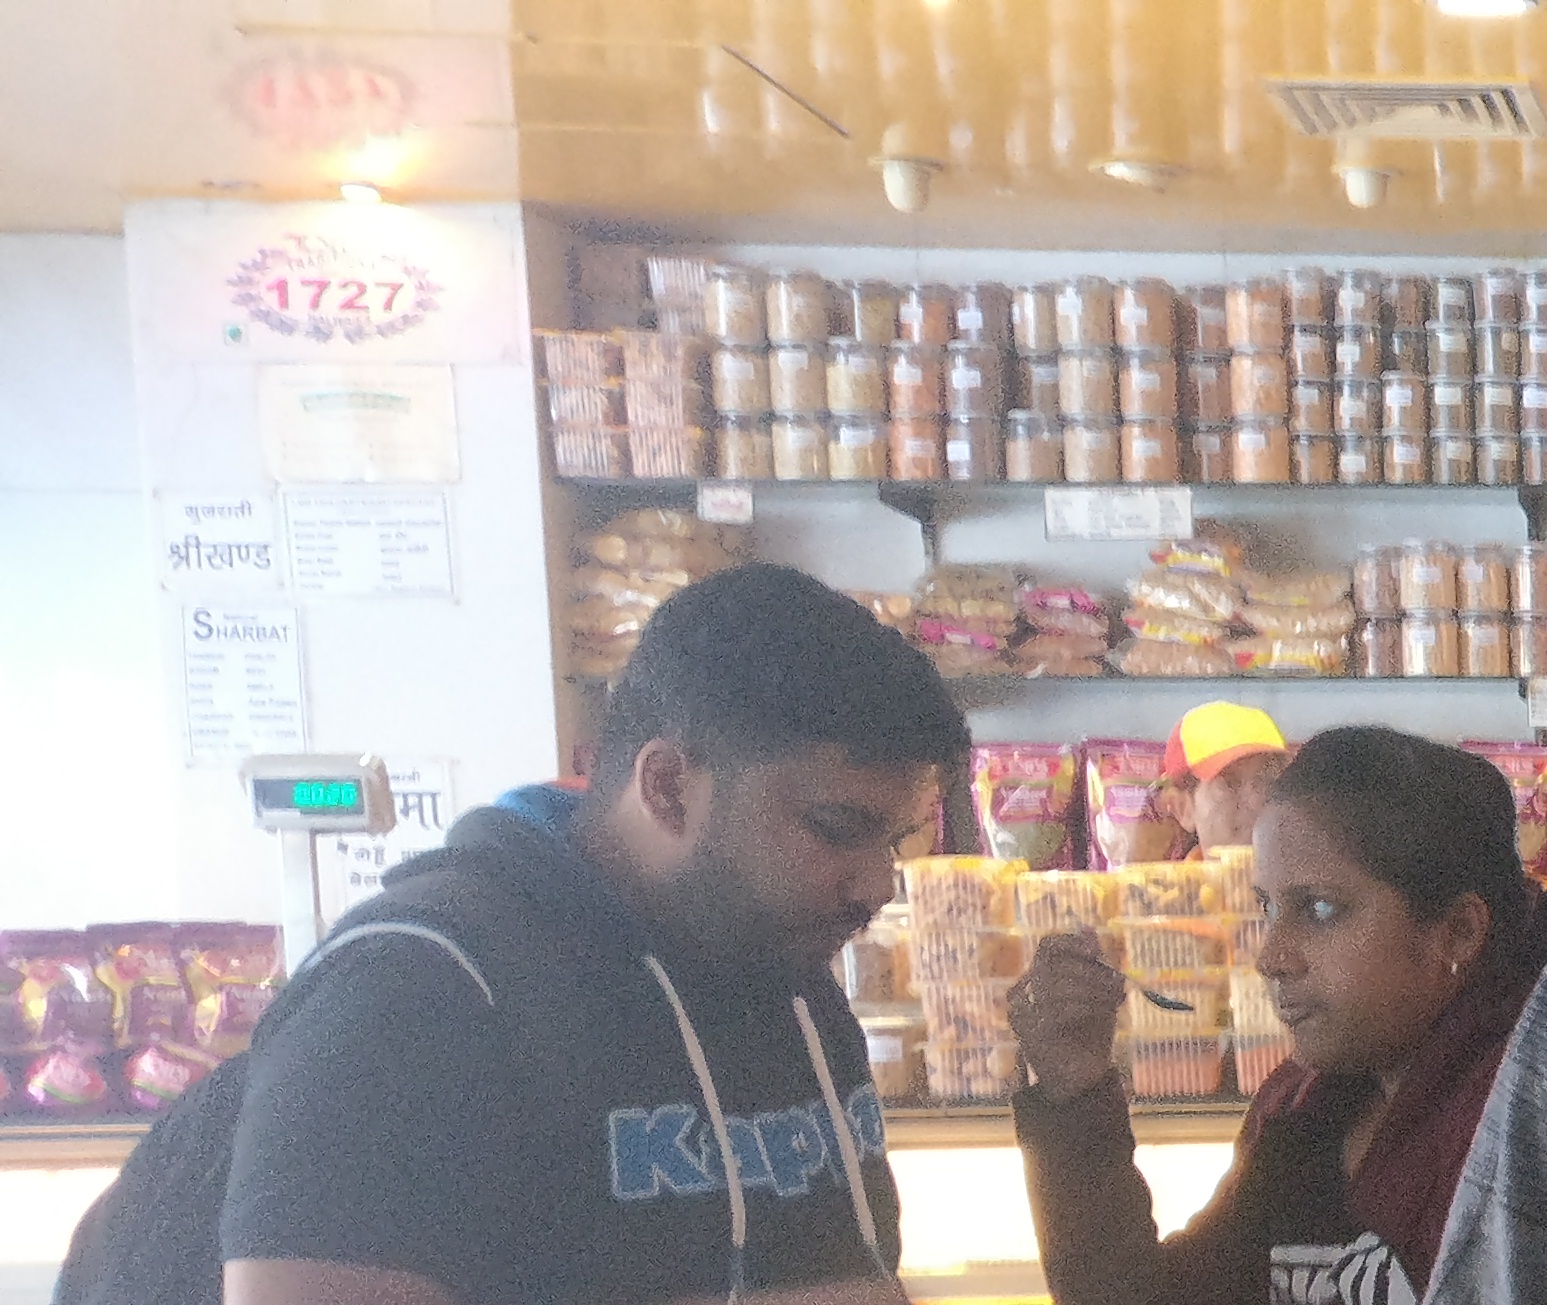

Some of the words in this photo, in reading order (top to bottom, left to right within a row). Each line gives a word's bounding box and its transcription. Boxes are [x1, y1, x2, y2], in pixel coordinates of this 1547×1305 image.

[265, 276, 406, 313] 1727
[168, 531, 272, 572] श्रीखण्ड
[192, 607, 292, 644] SHARBAT
